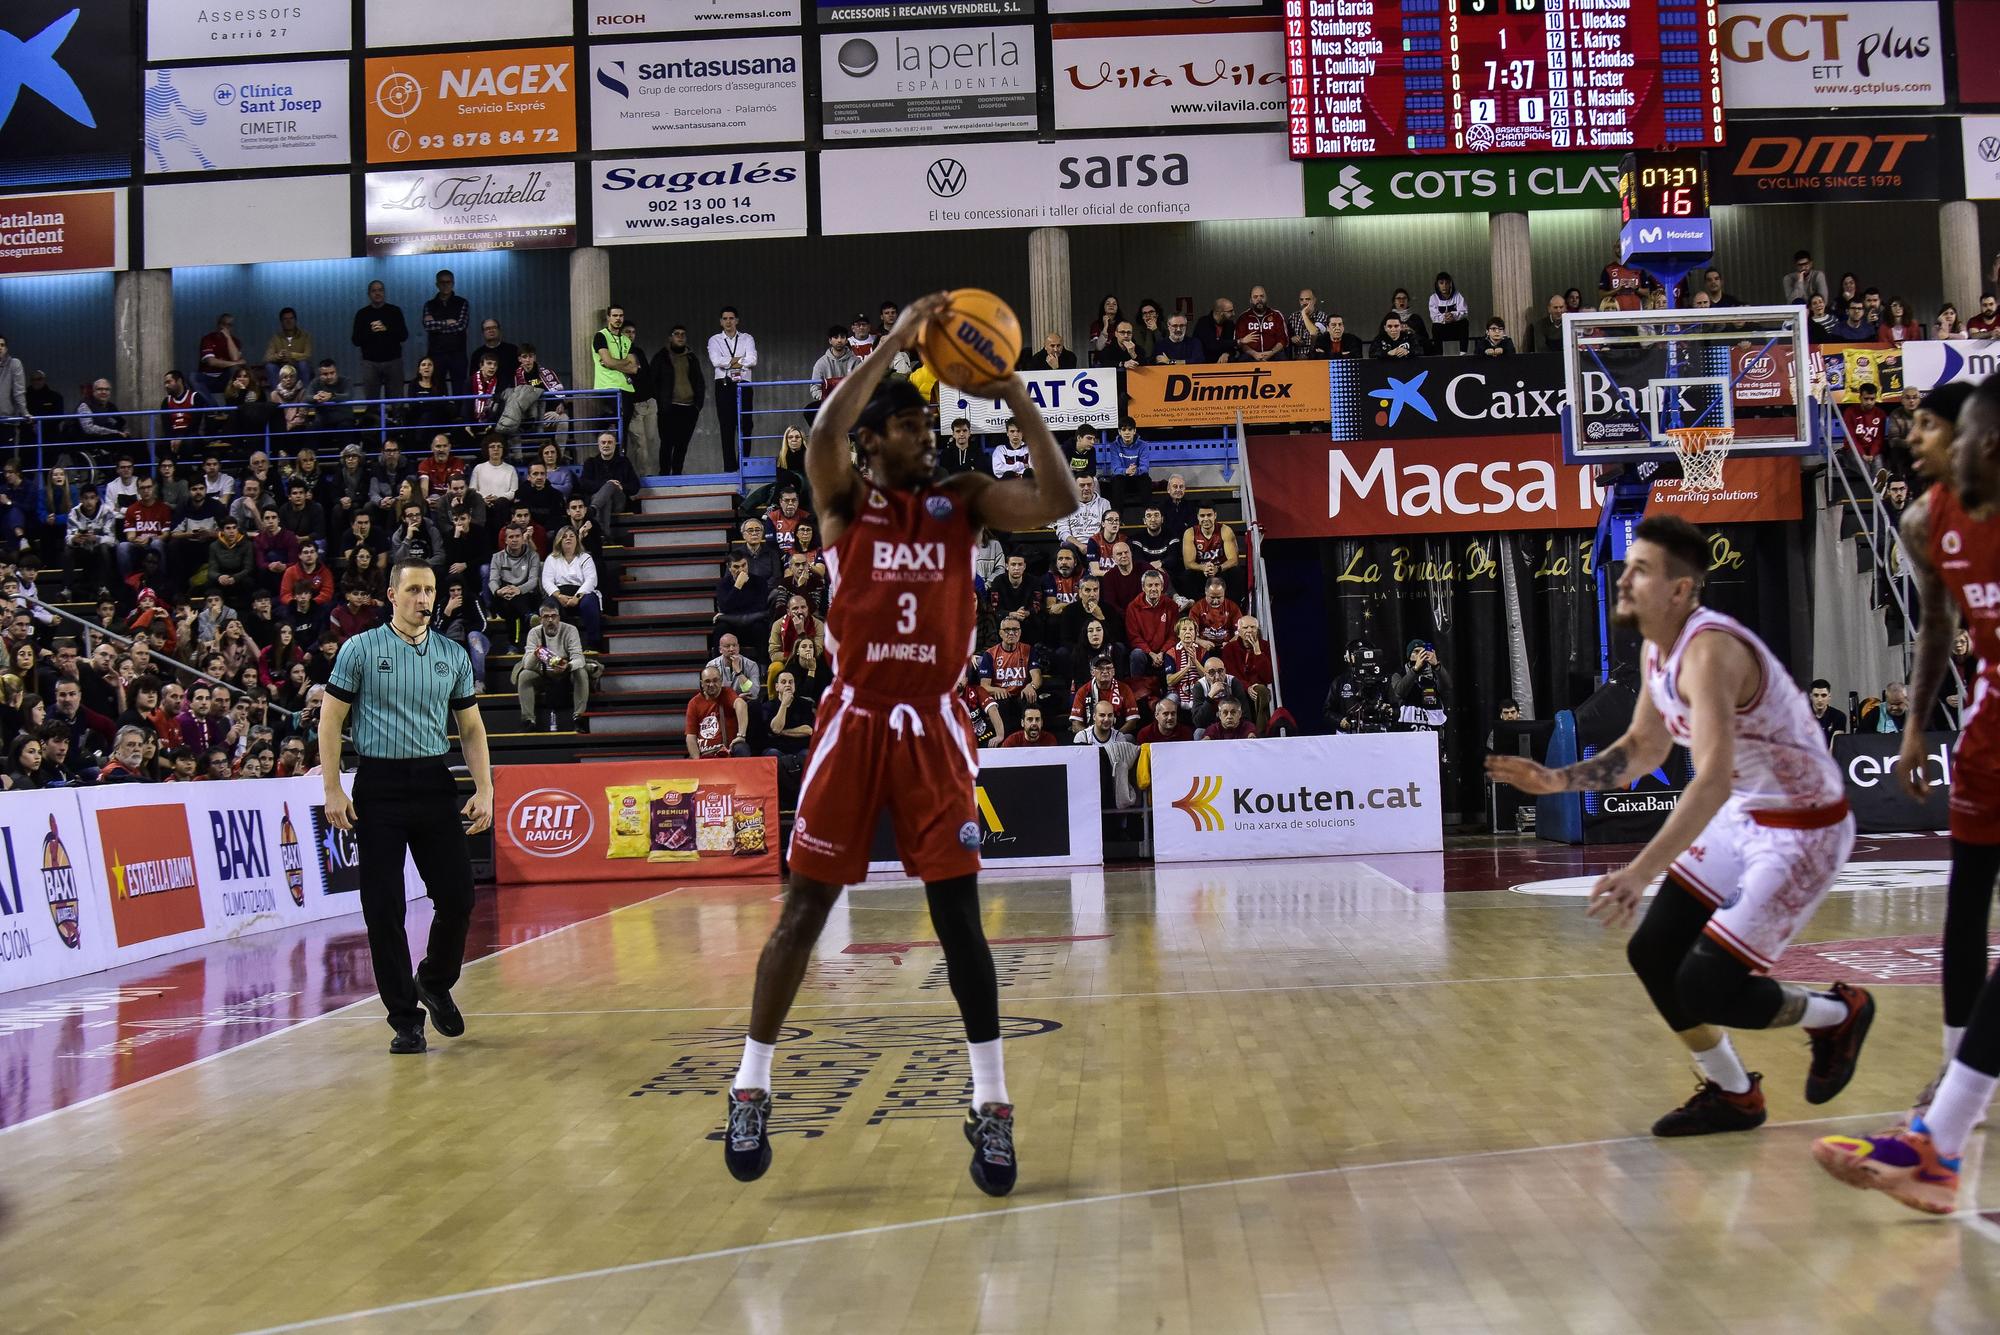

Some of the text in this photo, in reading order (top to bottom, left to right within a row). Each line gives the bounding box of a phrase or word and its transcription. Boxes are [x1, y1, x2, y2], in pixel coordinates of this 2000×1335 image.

[198, 7, 301, 23] Assessors
[694, 10, 792, 21] www.remsasl.com
[831, 2, 1021, 20] ACCESSORIS i RECANVIS VENDRELL, S.L.
[1287, 0, 1334, 17] 06 Dani
[597, 14, 645, 25] RICOH
[1289, 19, 1371, 37] 12 Steinbergs
[1569, 12, 1626, 29] L. Uleckas
[211, 29, 287, 40] Carrió 27
[1570, 30, 1621, 50] E. Kairys
[1289, 37, 1383, 57] 13 Musa Sagnia
[1719, 14, 1930, 77] GCT plus
[638, 57, 796, 80] santasusana
[1290, 57, 1375, 76] 16 L. Coulibaly
[1572, 51, 1635, 68] M. Echodas
[438, 63, 570, 99] NACEX
[1064, 59, 1287, 90] Vilà Vila
[1484, 60, 1535, 91] 7:37
[1573, 70, 1624, 88] M. Foster
[1812, 65, 1843, 79] ETT
[240, 84, 293, 98] Clínica
[638, 80, 797, 96] Grup de corredors d'assegurances
[897, 77, 1020, 92] ESPAIDENTAL
[1291, 76, 1365, 95] 17 F. Ferrari
[1814, 82, 1931, 95] www.gctplus.com
[240, 98, 322, 113] Sant Josep
[1170, 100, 1287, 114] www.vilavila.com
[1291, 96, 1362, 115] 22 J. Vaulet
[1573, 88, 1635, 107] G. Masiulis
[458, 101, 546, 115] Servicio Exprés
[620, 103, 777, 119] Manresa Barcelona Palamós
[1575, 108, 1626, 127] B. Varadi
[240, 120, 297, 135] CIMETIR
[652, 120, 746, 131] www.santasusana.com
[1292, 115, 1366, 134] 23 M. Geben
[418, 128, 559, 149] 93 878 84 72
[1292, 135, 1376, 154] 55 Dani Pérez
[1495, 132, 1551, 141] CHAMPIONS
[1495, 140, 1526, 148] LEAGUE
[1576, 128, 1634, 146] A. Simonis
[1732, 134, 1928, 176] DMT
[601, 162, 797, 193] Sagalés
[1059, 153, 1189, 190] sarsa
[1642, 167, 1697, 187] 07:37
[1390, 168, 1516, 199] COTS i
[1757, 175, 1902, 190] CYCLING SINCE 1978
[382, 176, 426, 211] La
[1662, 189, 1692, 215] 16
[648, 196, 751, 212] 902 13 00 14
[929, 201, 1190, 221] El teu concessionari i taller oficial de confiança
[443, 214, 498, 225] MANRESA
[625, 212, 776, 229] www.sagales.com
[1667, 230, 1704, 239] Movistar
[1164, 367, 1293, 402] Dimmtex
[1445, 371, 1696, 421] CaixaBank
[1073, 413, 1110, 424] esports
[1329, 448, 1556, 518] Macsa
[1655, 490, 1759, 504] & marking solutions
[873, 541, 945, 571] BAXI
[1336, 546, 1382, 583] La
[896, 592, 918, 635] 3
[866, 641, 936, 664] MANRESA
[996, 666, 1027, 680] BAXI
[1233, 781, 1422, 814] Kouten.cat
[520, 803, 581, 829] FRIT
[1234, 817, 1355, 831] Una xarxa de solucions
[208, 809, 271, 881] BAXI
[525, 829, 573, 842] RAVICH
[43, 867, 78, 901] BAXI
[126, 856, 195, 898] ESTRELLA DAMM
